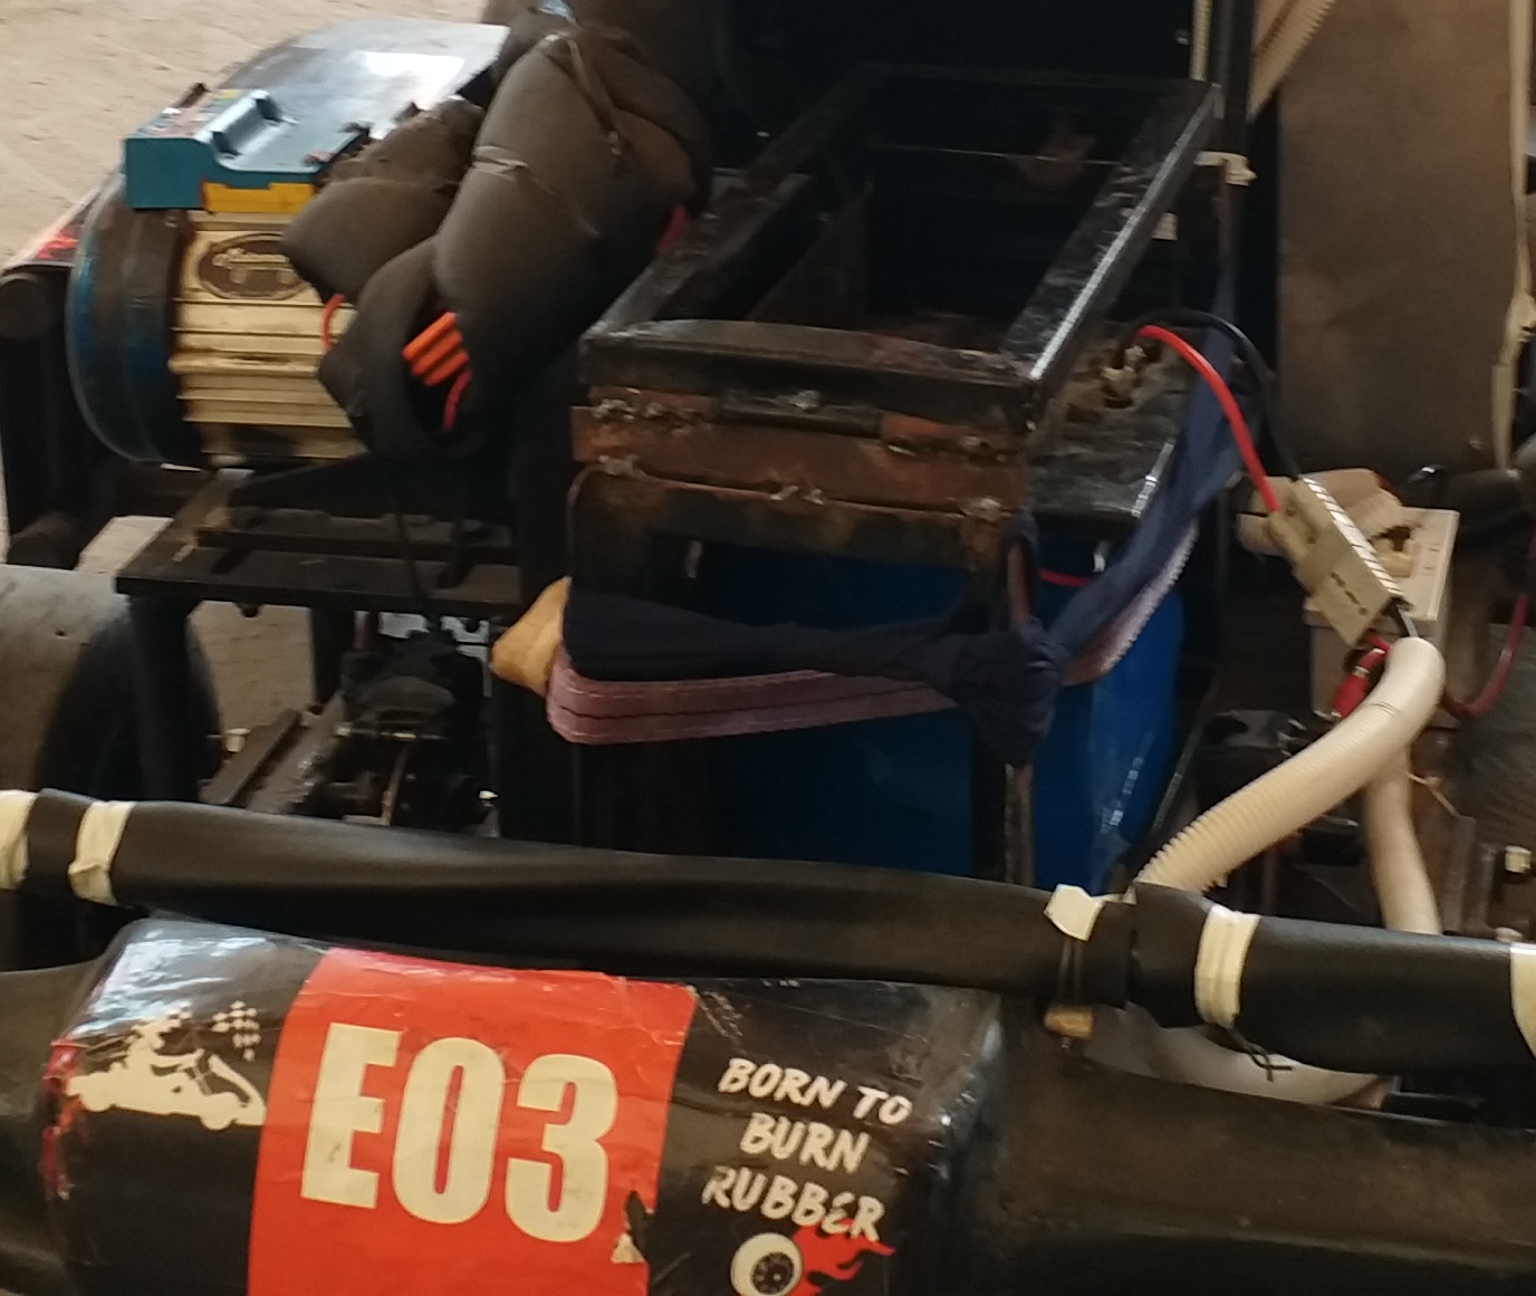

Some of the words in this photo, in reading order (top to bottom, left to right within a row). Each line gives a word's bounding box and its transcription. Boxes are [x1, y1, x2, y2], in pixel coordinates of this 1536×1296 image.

[717, 1057, 847, 1108] BORN
[852, 1085, 913, 1124] TO
[300, 1022, 619, 1243] E03
[739, 1111, 871, 1173] BURN
[700, 1164, 885, 1243] RUBBER
